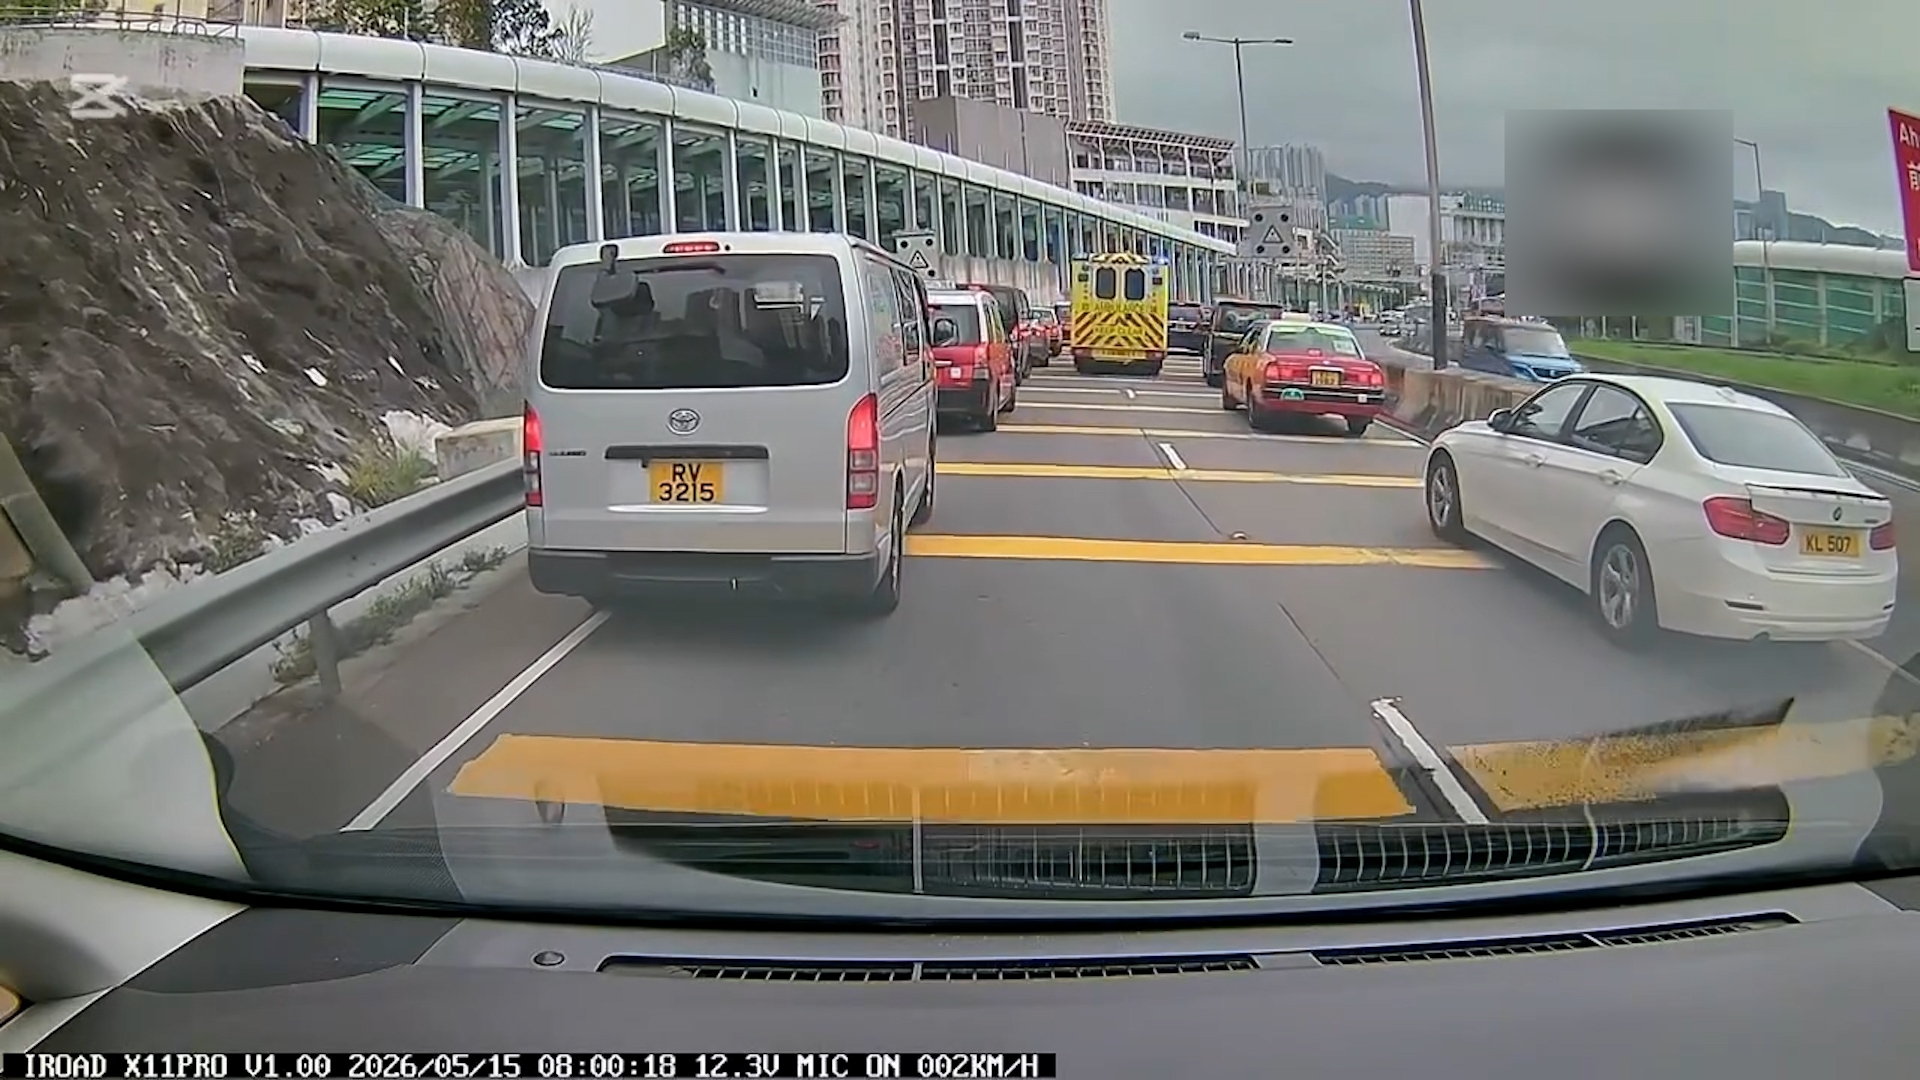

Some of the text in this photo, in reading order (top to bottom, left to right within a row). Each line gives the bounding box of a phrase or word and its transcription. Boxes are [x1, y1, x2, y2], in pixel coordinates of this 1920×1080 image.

[1095, 301, 1146, 312] AMBULANCE
[672, 463, 701, 482] RV
[659, 483, 715, 502] 3215
[1806, 536, 1852, 554] KL 507
